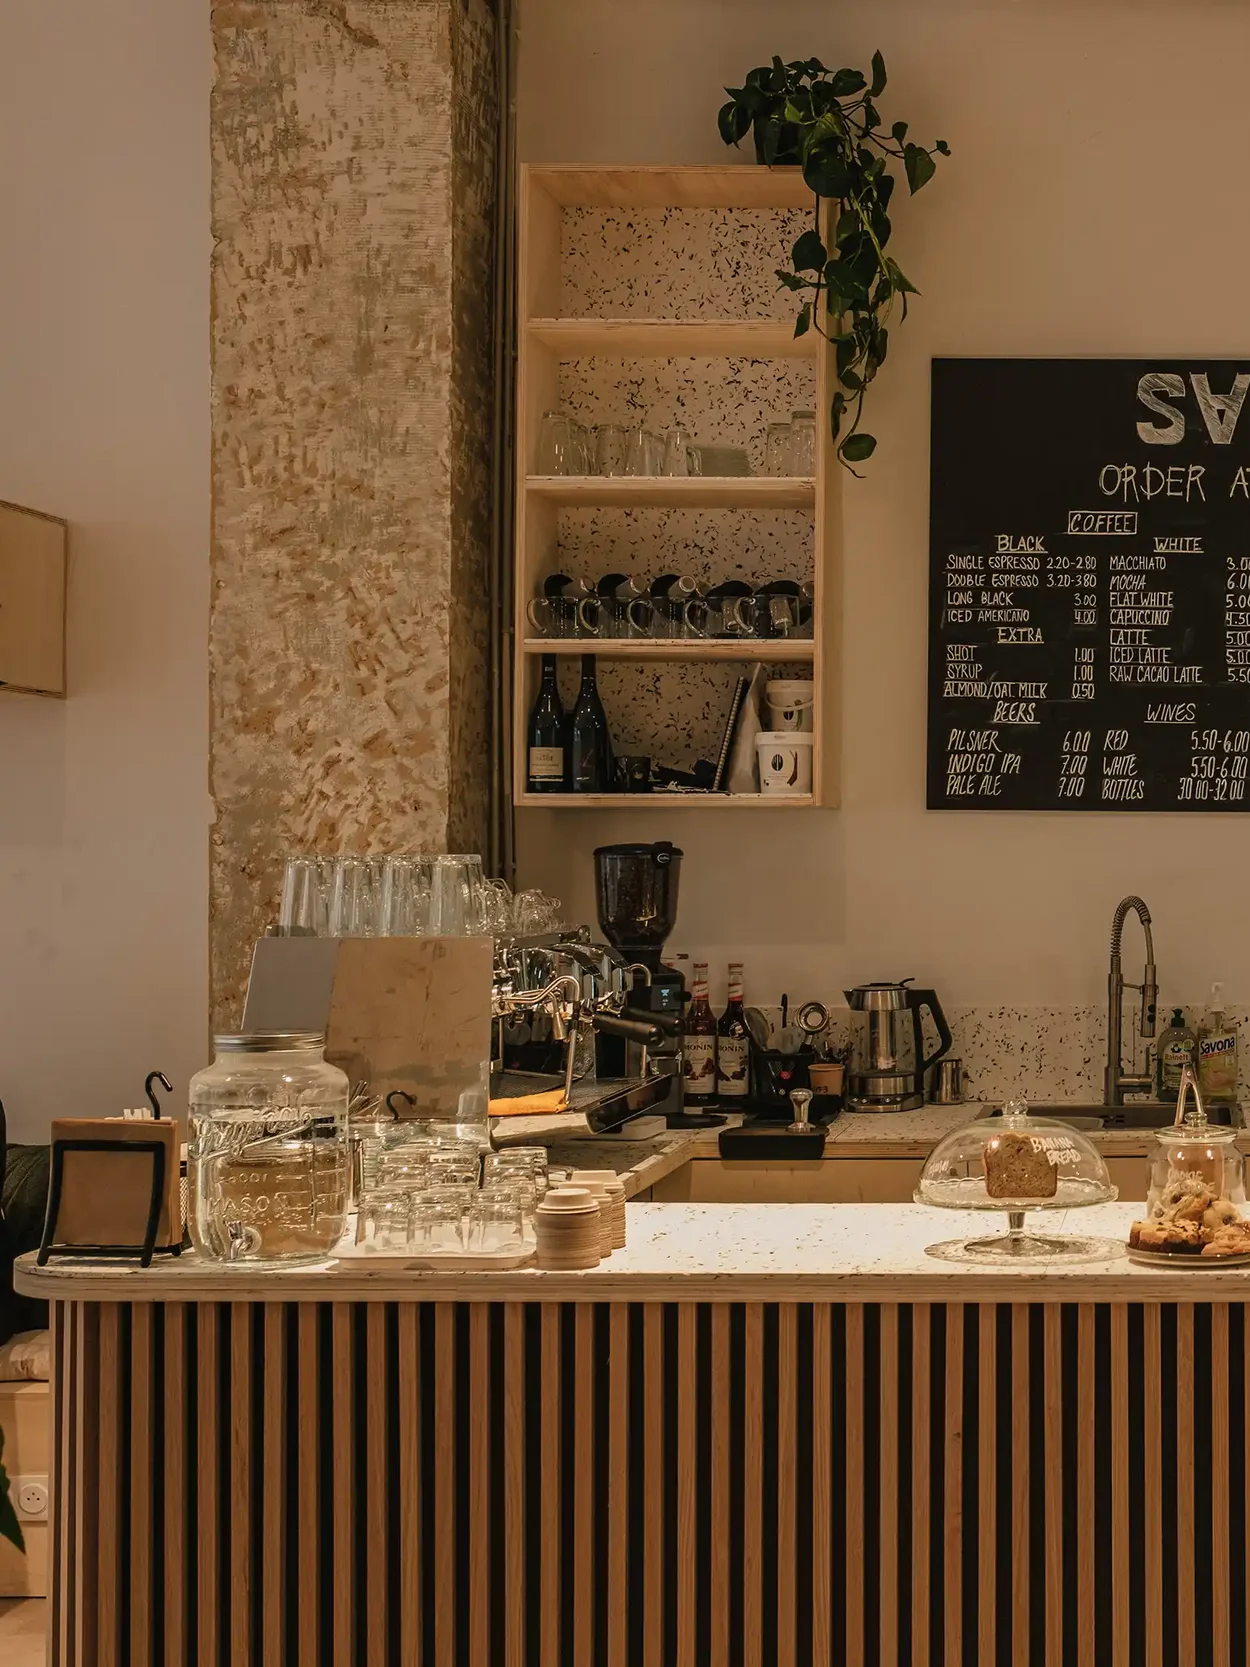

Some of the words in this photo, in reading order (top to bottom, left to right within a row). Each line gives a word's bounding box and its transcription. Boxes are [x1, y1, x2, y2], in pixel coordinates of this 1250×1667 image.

[1099, 461, 1206, 502] ORDER
[1070, 513, 1134, 532] COFFEE
[994, 534, 1046, 551] BLACK
[1154, 537, 1203, 551] WHITE
[946, 554, 985, 570] SINGLE
[988, 555, 1040, 570] ESPRESSO
[1110, 555, 1167, 571] MACCHIATO
[946, 573, 986, 587] DOUBLE
[991, 573, 1039, 587] ESPRESSO
[1109, 574, 1147, 591] MOCHA
[947, 590, 973, 605] LONG
[981, 591, 1014, 606] BLACK
[1073, 592, 1097, 607] 3.00
[1109, 591, 1139, 607] FLAT
[1140, 591, 1174, 607] WHITE
[947, 609, 973, 623] ICED
[977, 609, 1030, 622] AMERICANO
[1073, 609, 1097, 624] 4.00
[1109, 609, 1172, 625] CAPUCCINO
[997, 626, 1043, 642] EXTRA
[1109, 628, 1152, 645] LATTE
[946, 644, 978, 661] SHOT
[1074, 647, 1095, 663] 1.00
[1109, 647, 1134, 663] ICED
[1138, 647, 1172, 663] LATTE
[946, 663, 983, 679] SYRUP
[1073, 664, 1094, 681] 1.00
[1109, 665, 1134, 682] RAW
[1136, 665, 1170, 682] CACAO
[1173, 666, 1203, 683] LATTE
[1018, 682, 1048, 698] MILK
[993, 701, 1036, 722] BEERS
[1147, 702, 1197, 722] WINES
[947, 728, 1003, 752] PILSNER
[1062, 730, 1092, 752] 6.00
[1103, 729, 1129, 751] RED
[1190, 729, 1250, 753] 5.50-6.00
[946, 753, 996, 774] INDIGO
[1000, 753, 1022, 774] IPA
[1061, 755, 1088, 775] 7.00
[1103, 753, 1138, 776] WHITE
[946, 775, 977, 795] PALE
[978, 775, 1002, 796] ALE
[1058, 777, 1086, 797] 7.00
[1101, 778, 1145, 801] BOTTLES
[1200, 1036, 1235, 1055] Savona
[1030, 1136, 1075, 1154] BANANA
[1046, 1148, 1081, 1166] BREAD
